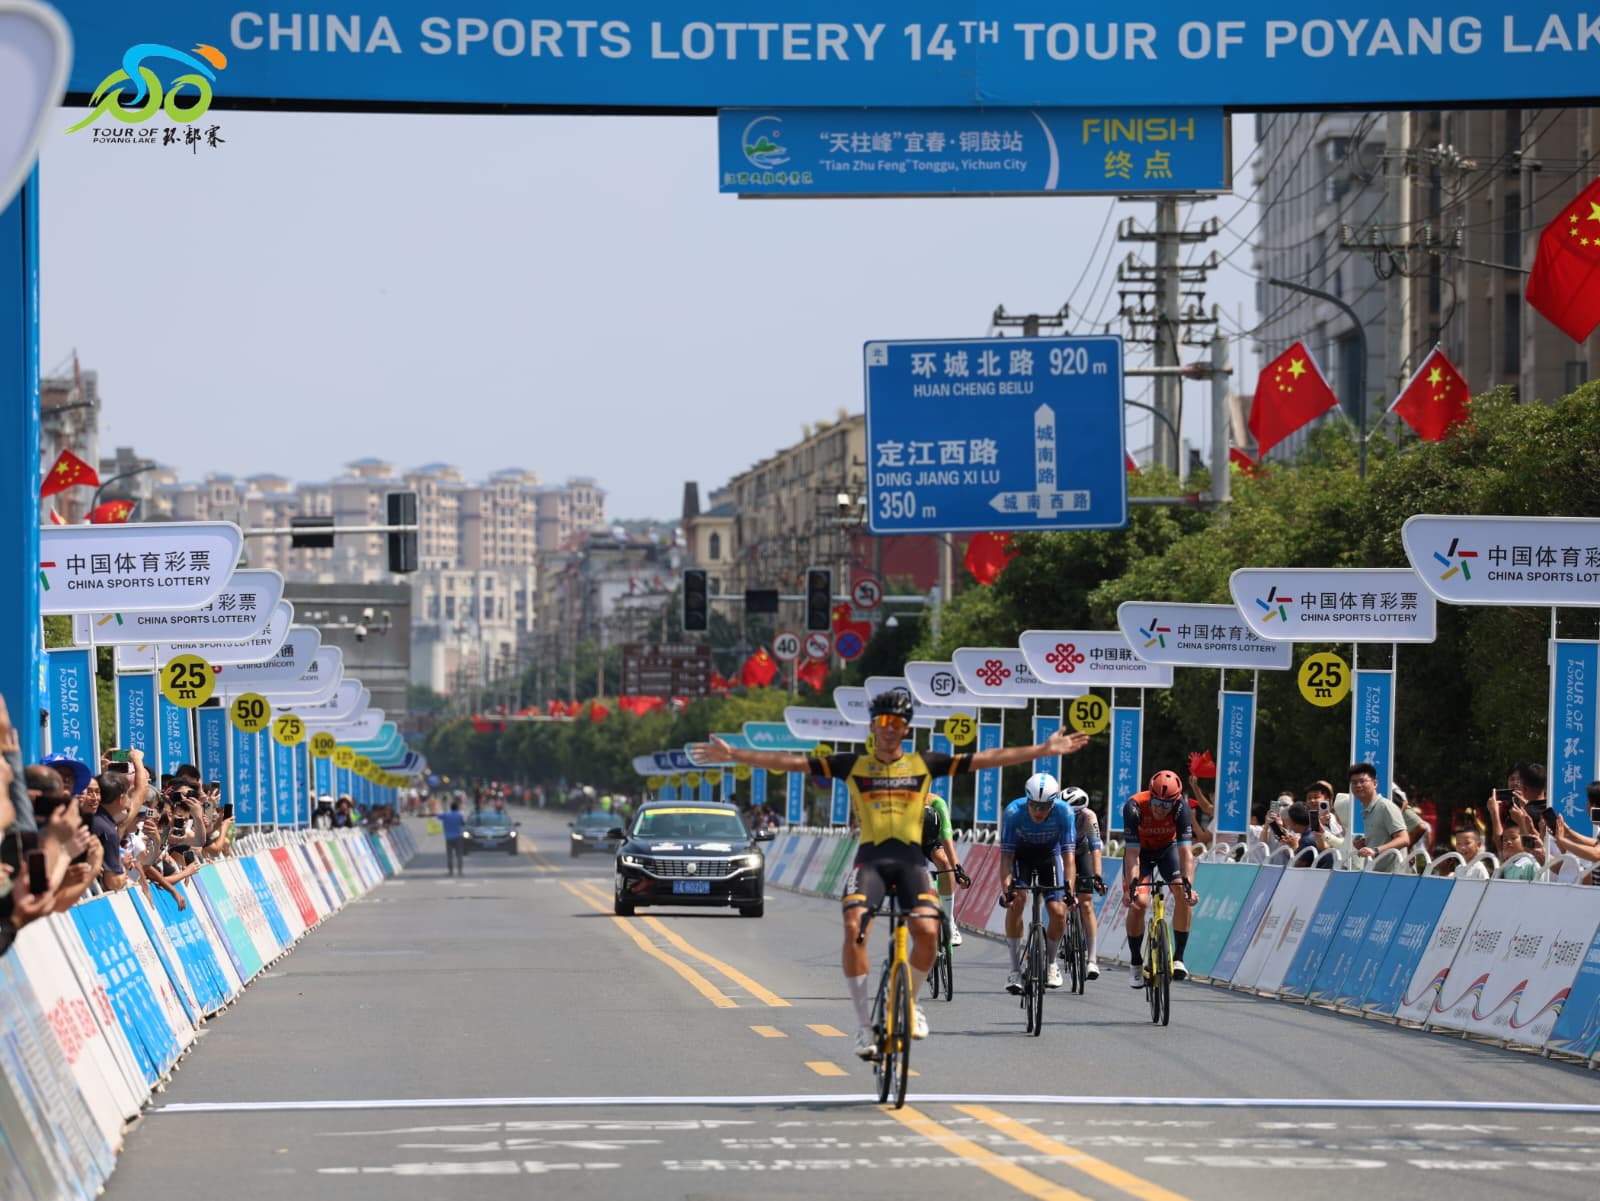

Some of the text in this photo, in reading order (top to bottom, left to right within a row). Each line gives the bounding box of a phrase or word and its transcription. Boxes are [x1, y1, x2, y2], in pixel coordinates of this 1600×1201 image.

[230, 11, 402, 53] CHINA
[420, 17, 631, 58] SPORTS
[652, 22, 886, 61] LOTTERY
[904, 21, 999, 61] 14TH
[1014, 22, 1158, 61] TOUR
[1178, 21, 1246, 59] OF
[1266, 16, 1482, 58] POYANG
[1082, 118, 1194, 144] FINISH
[852, 160, 875, 171] Zhu
[962, 159, 1000, 170] Yichun
[1004, 159, 1028, 172] City
[1104, 149, 1173, 179] 终点
[912, 348, 1107, 379] 环城北路 920 m
[914, 381, 1034, 397] HUAN CHENG BEILU
[876, 438, 998, 468] 定江西路
[1036, 424, 1054, 485] 城南路
[876, 470, 1000, 487] DING JIANG XI LU
[880, 491, 936, 519] 350 m
[66, 550, 210, 576] 中国体育彩票
[68, 576, 210, 590] CHINA SPORTS LOTTERY
[1488, 571, 1523, 581] CHINA
[1526, 572, 1574, 582] SPORTS
[1300, 592, 1418, 610] 中国体育彩票
[138, 614, 257, 624] CHINA SPORTS LOTTERY
[1300, 614, 1417, 622] CHINA SPORTS LOTTERY
[777, 638, 797, 654] 40
[1090, 648, 1138, 661] 中国联
[1205, 642, 1238, 651] SPORTS
[1239, 644, 1276, 653] LOTTERY
[170, 663, 206, 689] 25
[1307, 662, 1342, 688] 25
[1567, 659, 1575, 703] POYANG
[60, 668, 68, 710] POYANG
[935, 679, 951, 691] SF
[1315, 688, 1332, 697] m
[67, 667, 80, 740] TOUR OF
[179, 690, 195, 699] m
[1574, 660, 1584, 732] TOUR OF
[237, 700, 264, 718] 50
[1076, 702, 1102, 720] 50
[1371, 686, 1380, 746] TOUR OF
[136, 690, 144, 750] TOUR OF
[172, 706, 180, 737] TOUR
[278, 720, 300, 735] 75
[950, 719, 970, 734] 75
[1234, 705, 1244, 756] TOUR OF
[174, 741, 182, 756] OF
[314, 739, 334, 748] 100
[213, 751, 220, 764] OF
